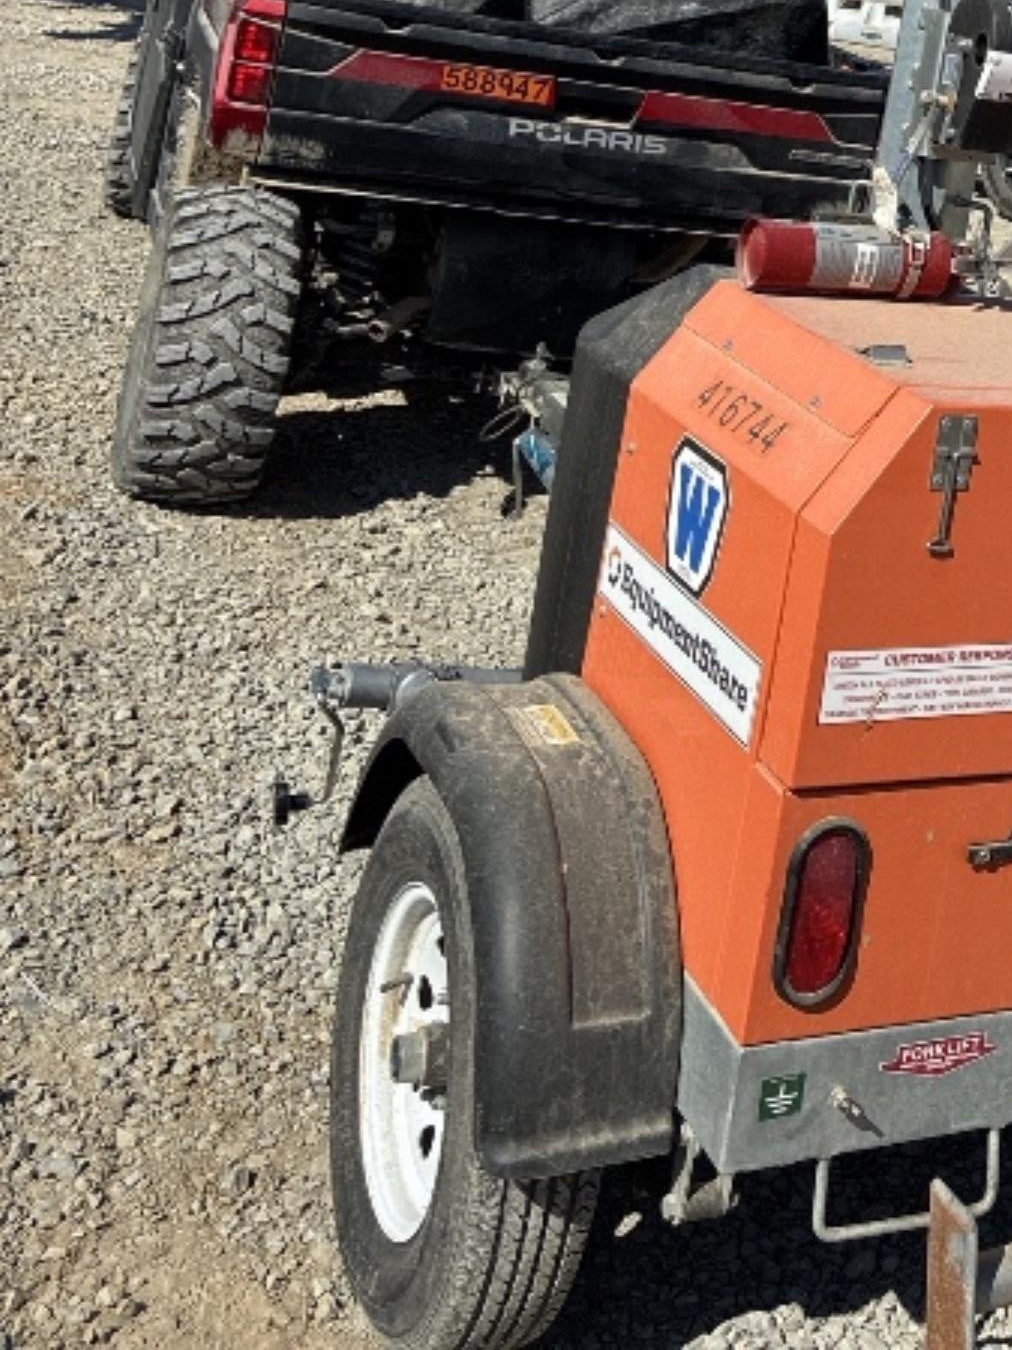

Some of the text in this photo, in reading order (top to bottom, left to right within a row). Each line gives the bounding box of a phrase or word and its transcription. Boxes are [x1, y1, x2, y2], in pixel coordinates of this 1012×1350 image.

[442, 67, 553, 103] 588947
[508, 117, 668, 155] POLARIS
[697, 379, 788, 454] 416744
[673, 461, 721, 574] W
[620, 561, 748, 713] EquipmentShare
